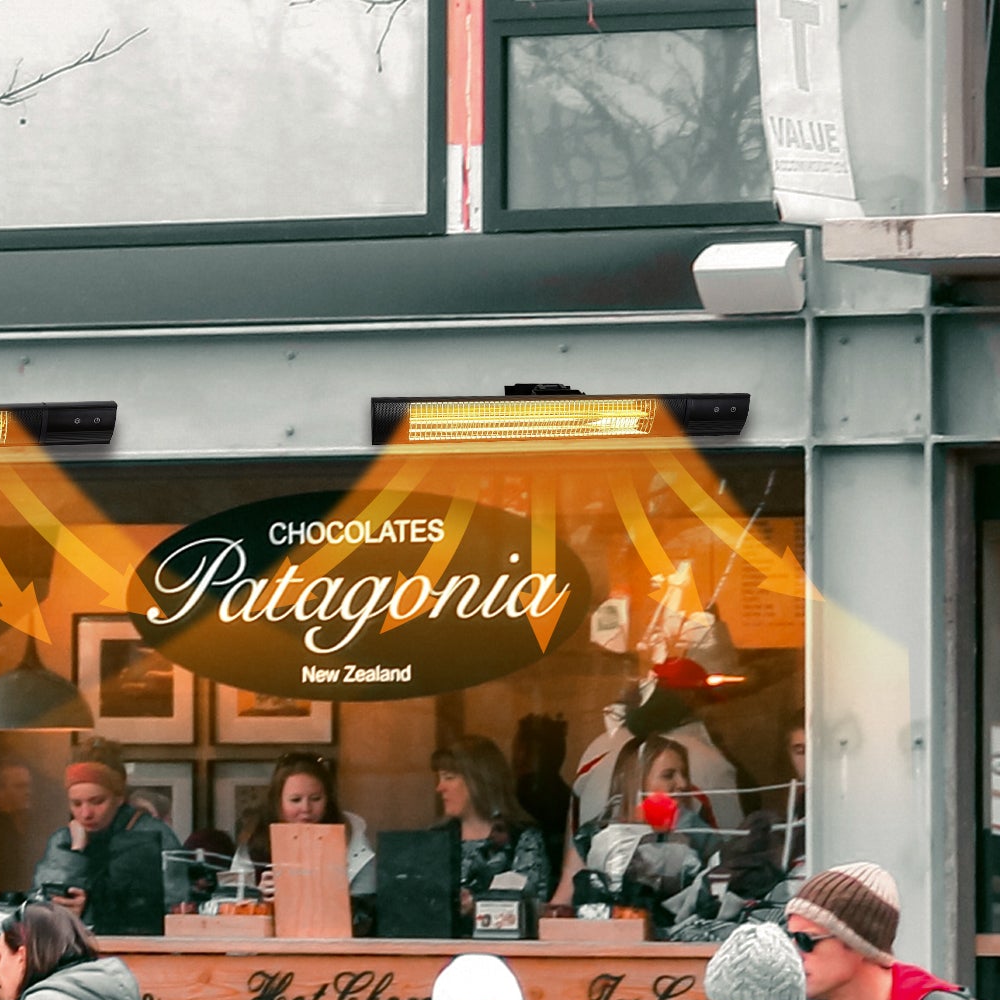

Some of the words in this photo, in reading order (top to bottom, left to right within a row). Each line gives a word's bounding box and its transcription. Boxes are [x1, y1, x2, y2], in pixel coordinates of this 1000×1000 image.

[769, 115, 841, 153] VALUE
[268, 518, 445, 545] CHOCOLATES
[146, 536, 571, 655] Patagonia
[301, 665, 340, 684] New
[343, 663, 412, 683] Zealand
